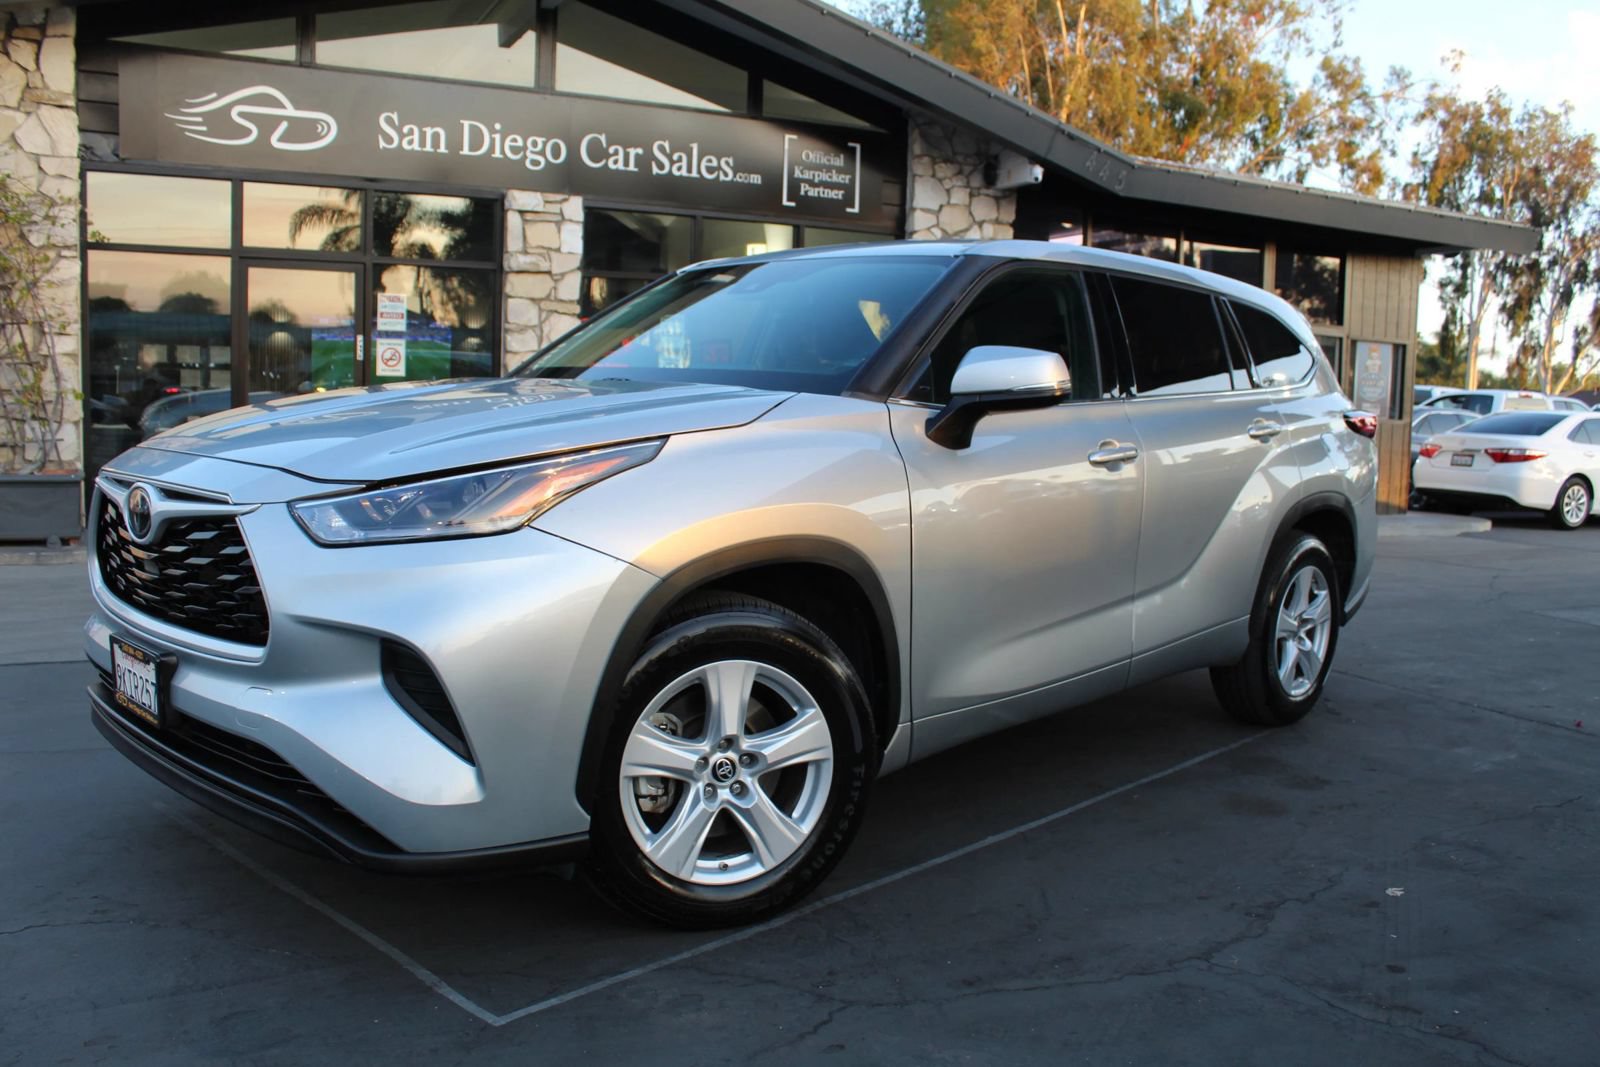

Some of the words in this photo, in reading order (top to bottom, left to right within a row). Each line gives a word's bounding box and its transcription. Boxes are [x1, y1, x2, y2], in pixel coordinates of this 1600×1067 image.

[377, 110, 450, 154] San
[458, 118, 568, 171] Diego
[579, 132, 645, 173] Car
[650, 139, 764, 186] Sales.com
[800, 149, 846, 168] Official
[792, 165, 852, 185] Karpicker
[799, 182, 846, 200] Partner
[116, 662, 159, 713] 9KIR257
